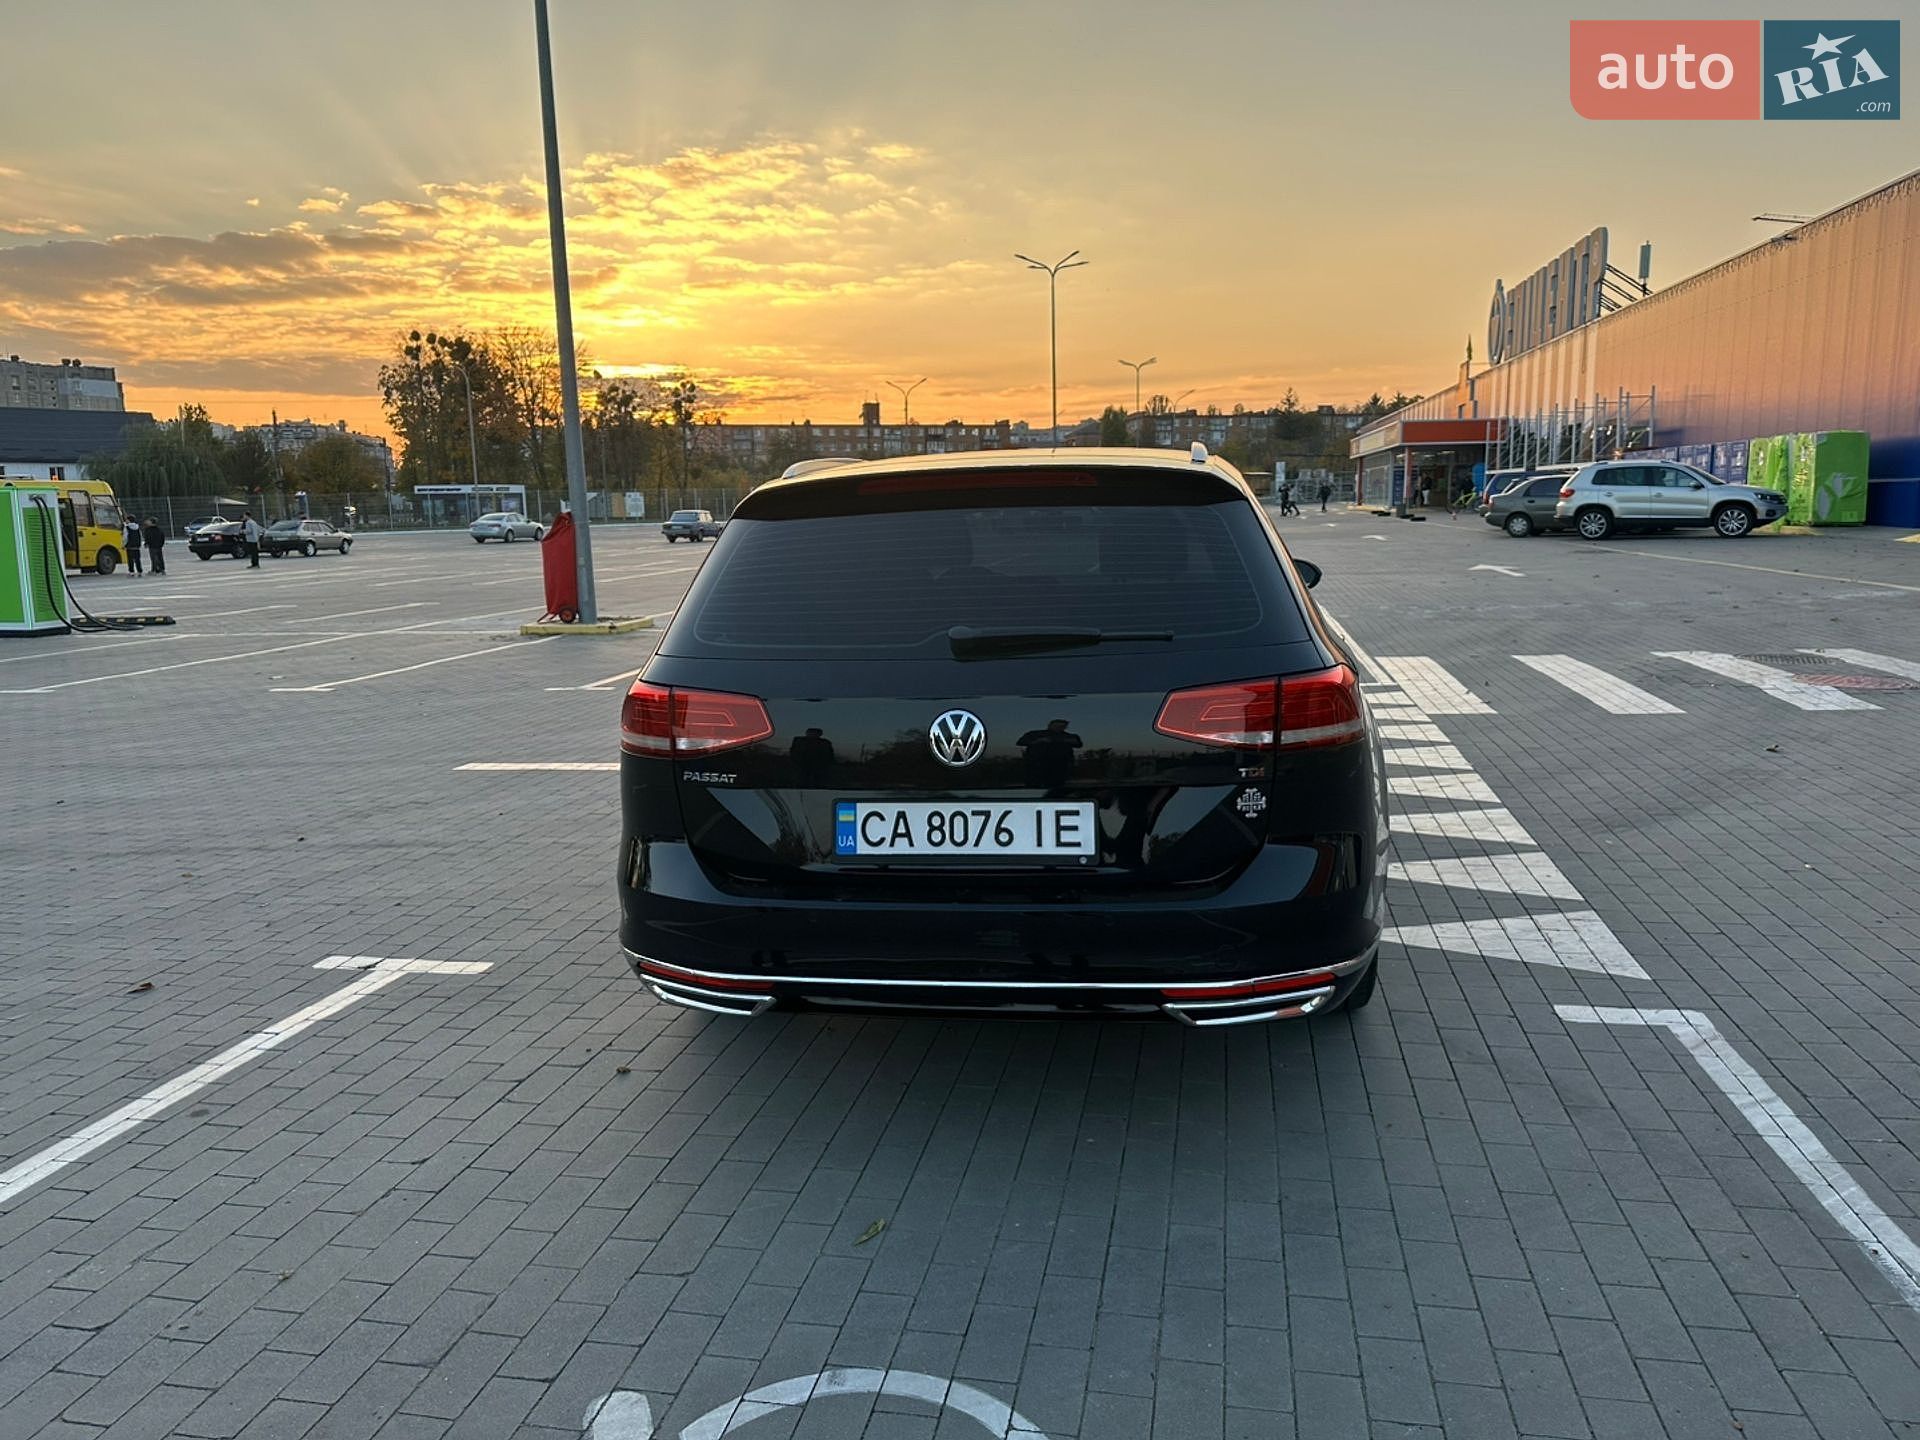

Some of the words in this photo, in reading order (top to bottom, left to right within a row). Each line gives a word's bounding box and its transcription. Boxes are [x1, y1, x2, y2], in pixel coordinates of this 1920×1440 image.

[683, 771, 737, 784] PASSAT
[861, 810, 915, 848] CA
[926, 810, 1015, 848] 8076
[1035, 810, 1082, 848] IE
[838, 835, 855, 847] UA
